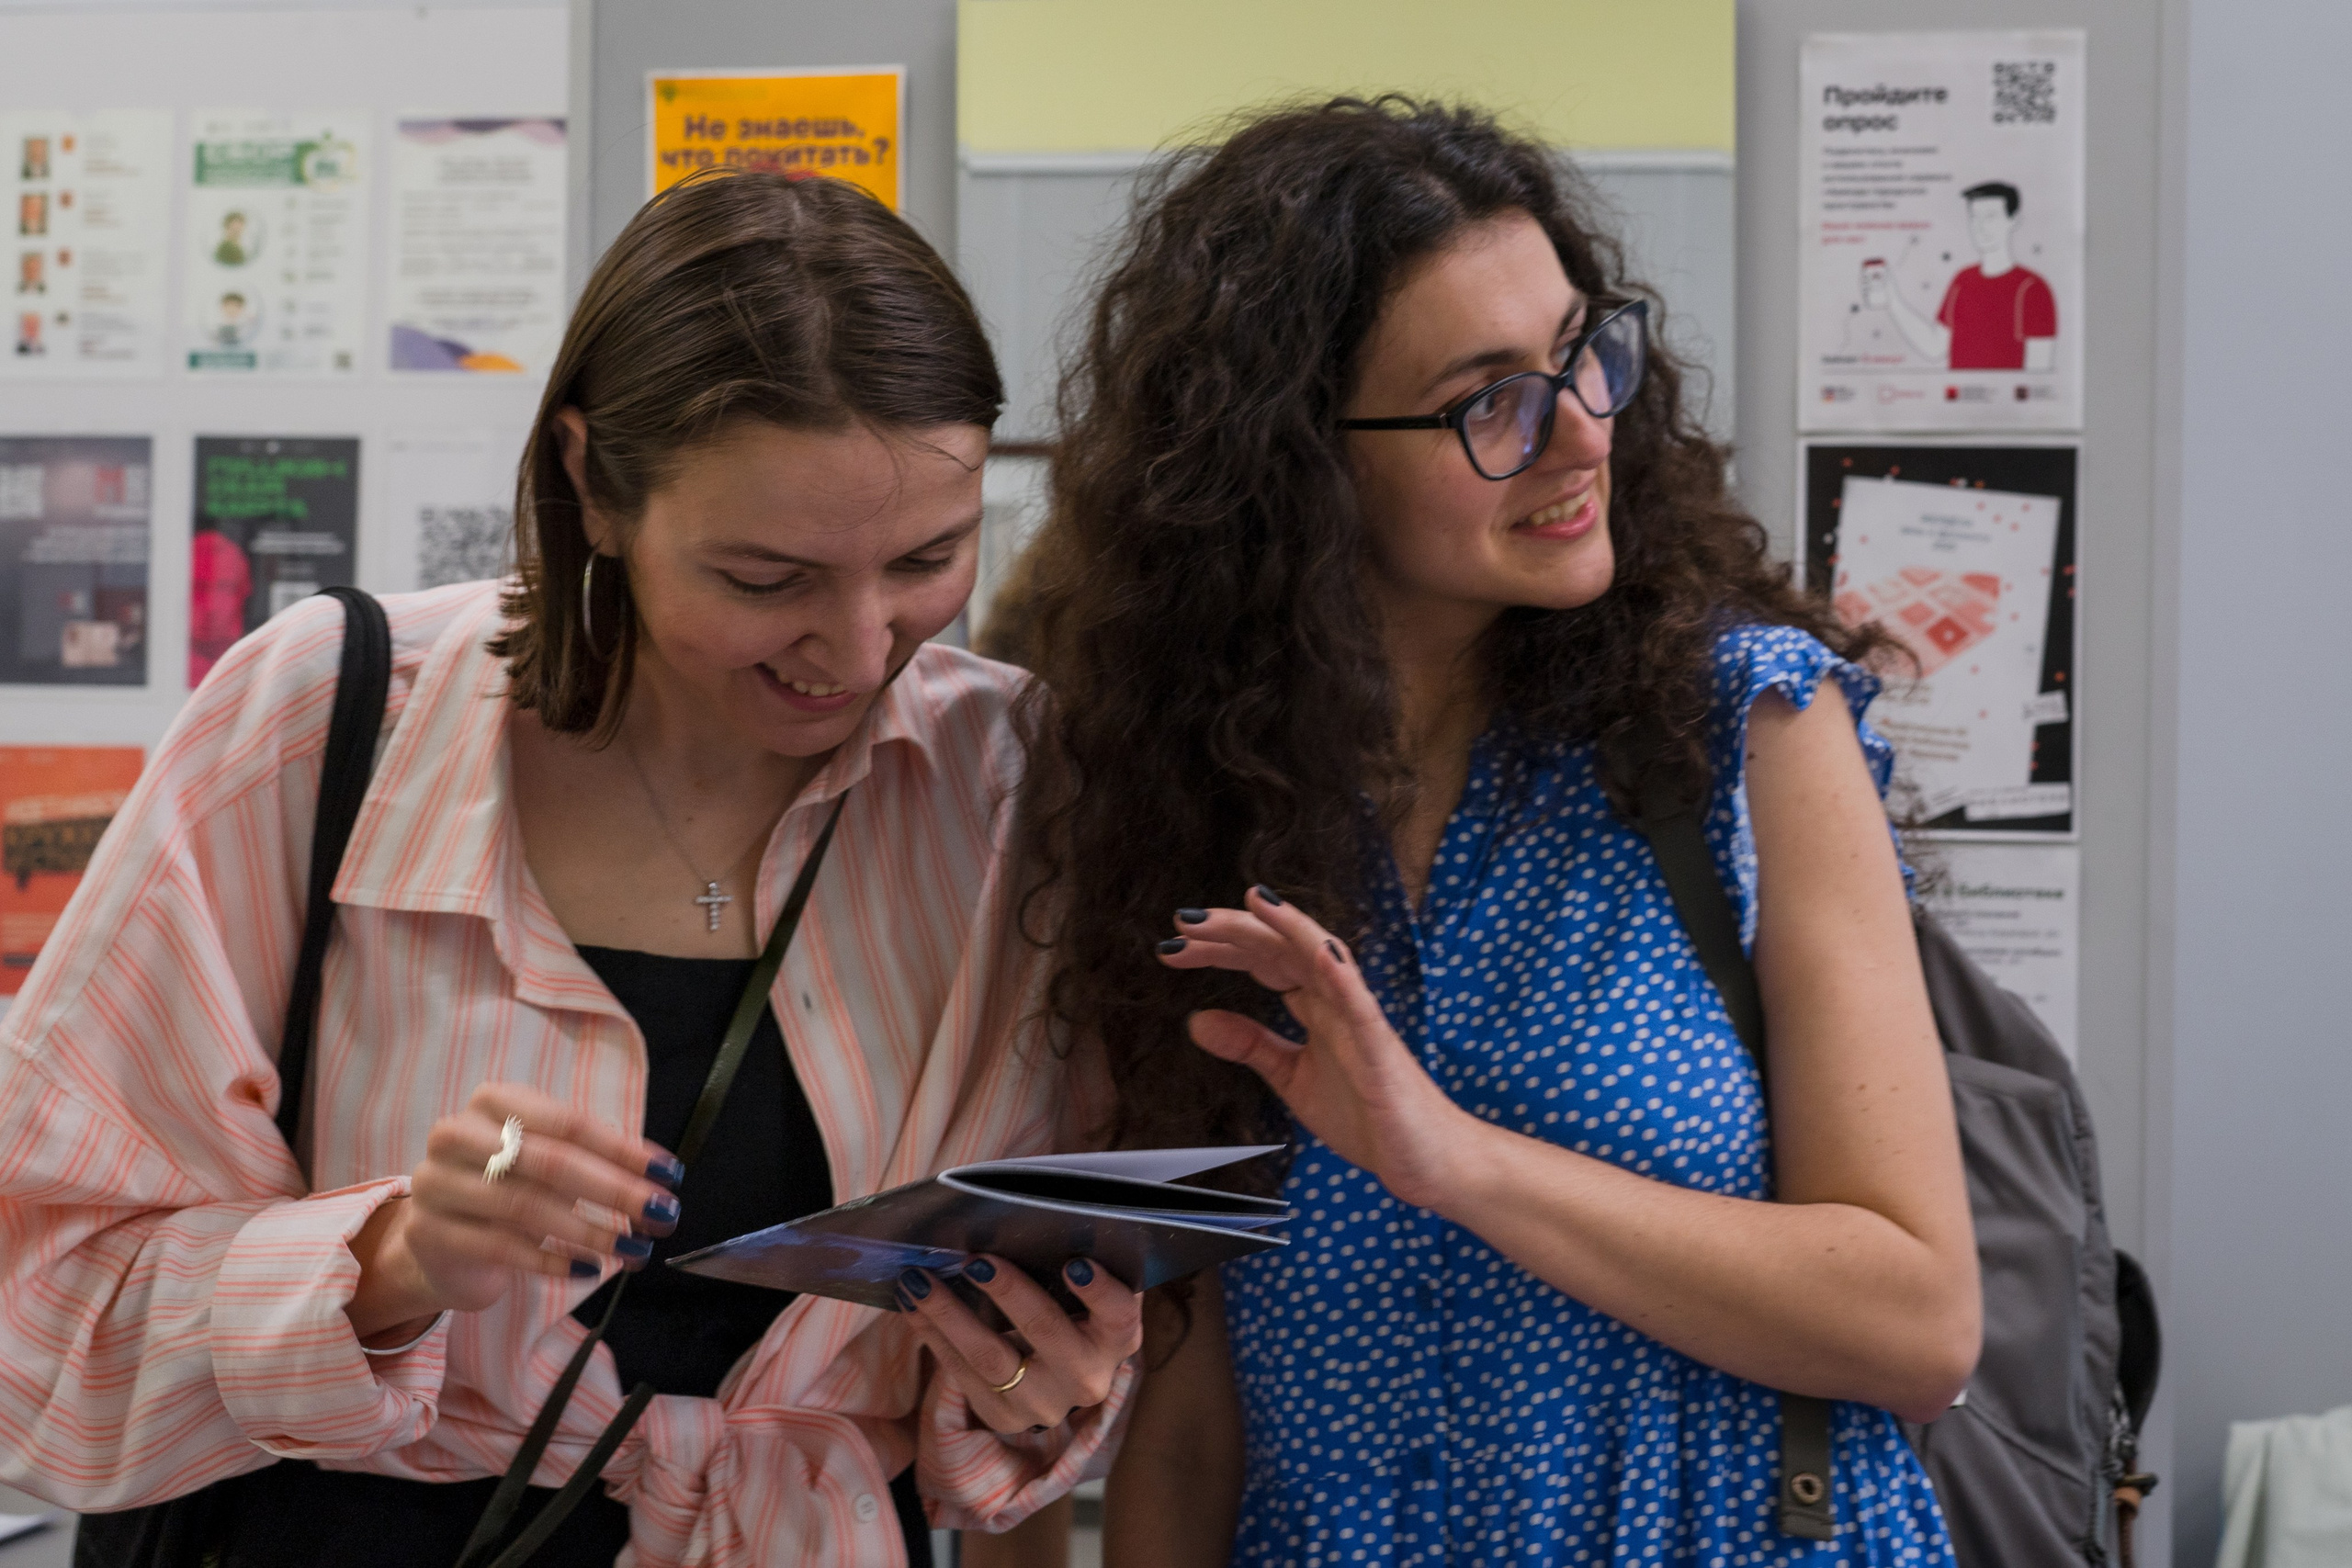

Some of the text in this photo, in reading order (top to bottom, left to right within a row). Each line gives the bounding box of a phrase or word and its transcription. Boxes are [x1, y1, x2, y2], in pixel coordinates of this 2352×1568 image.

[1824, 84, 1947, 106] Пройдите
[683, 114, 865, 140] Не знаешь,
[661, 148, 715, 167] что
